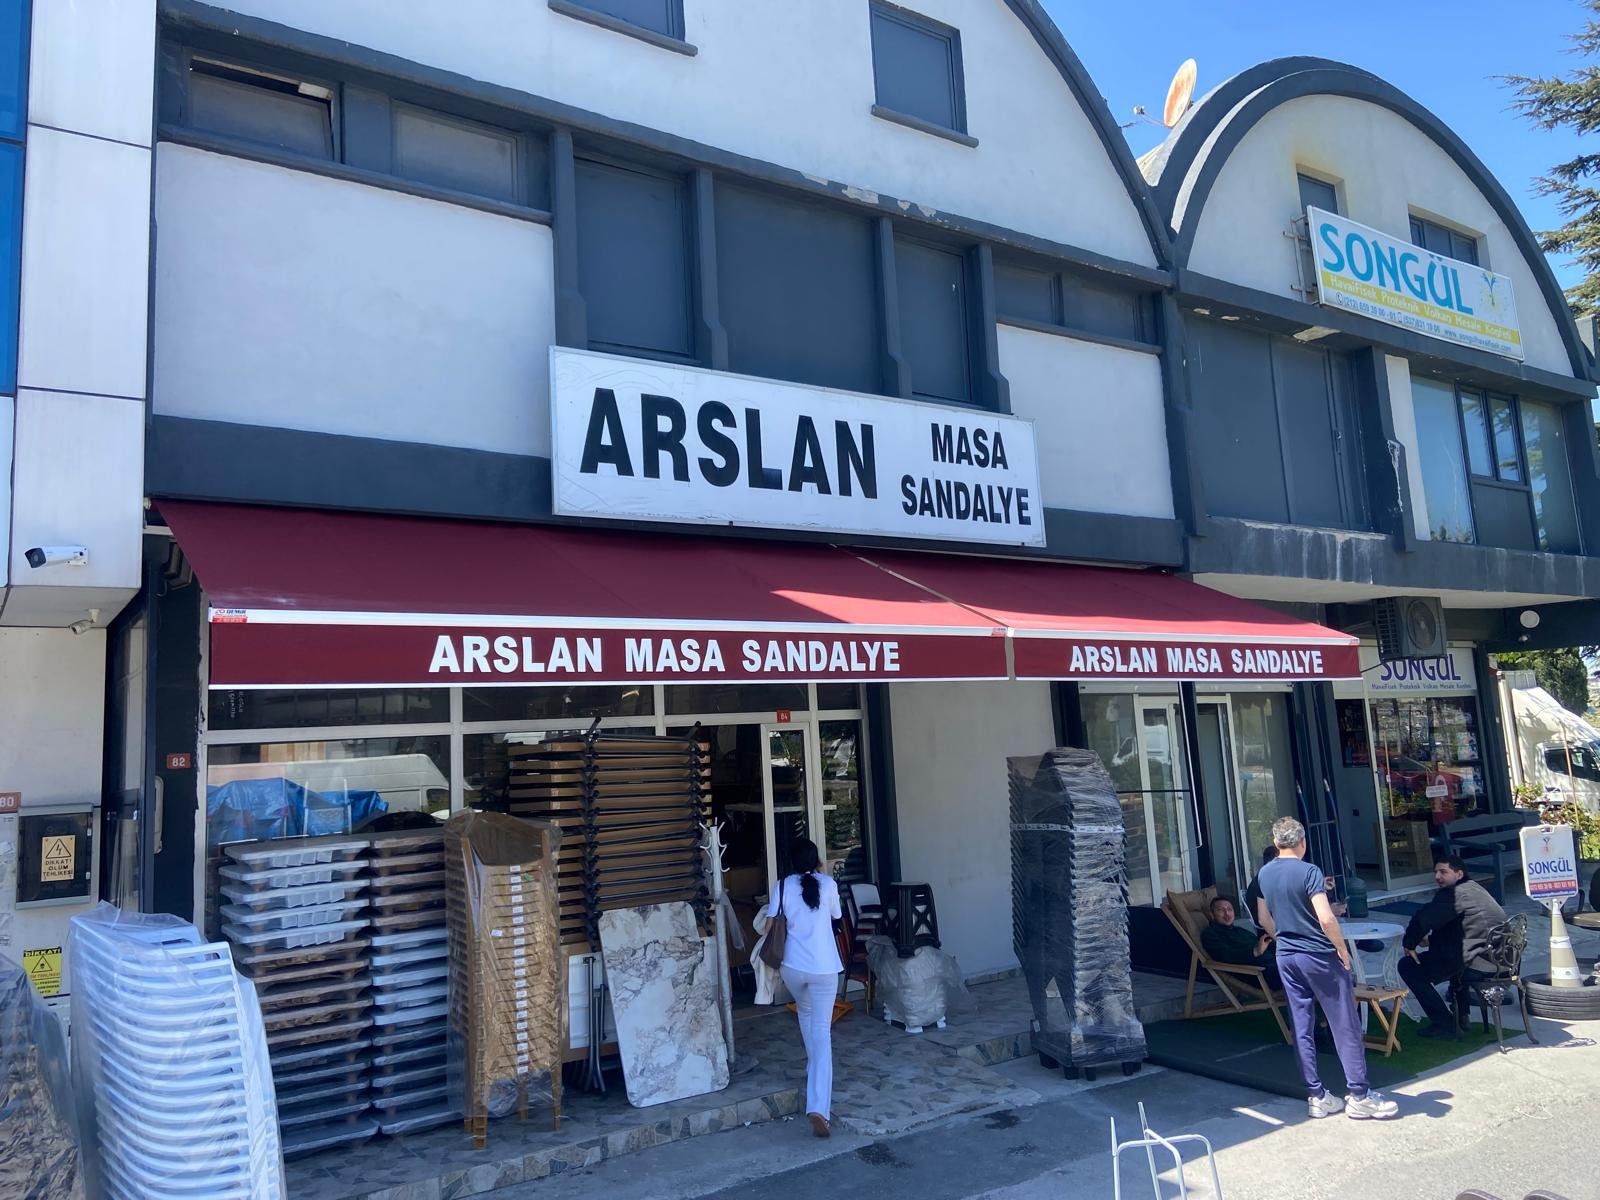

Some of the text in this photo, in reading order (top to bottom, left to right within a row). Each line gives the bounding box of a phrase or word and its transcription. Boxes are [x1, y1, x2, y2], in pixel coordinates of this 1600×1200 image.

[1320, 223, 1473, 316] SONGÜL
[580, 387, 877, 499] ARSLAN
[931, 423, 1008, 470] MASA
[901, 475, 1032, 525] SANDALYE
[428, 635, 901, 674] ARSLAN MASA SANDALYE
[1069, 645, 1324, 674] ARSLAN MASA SANDALYE
[172, 757, 185, 767] 82
[1528, 857, 1573, 875] SONGÜL
